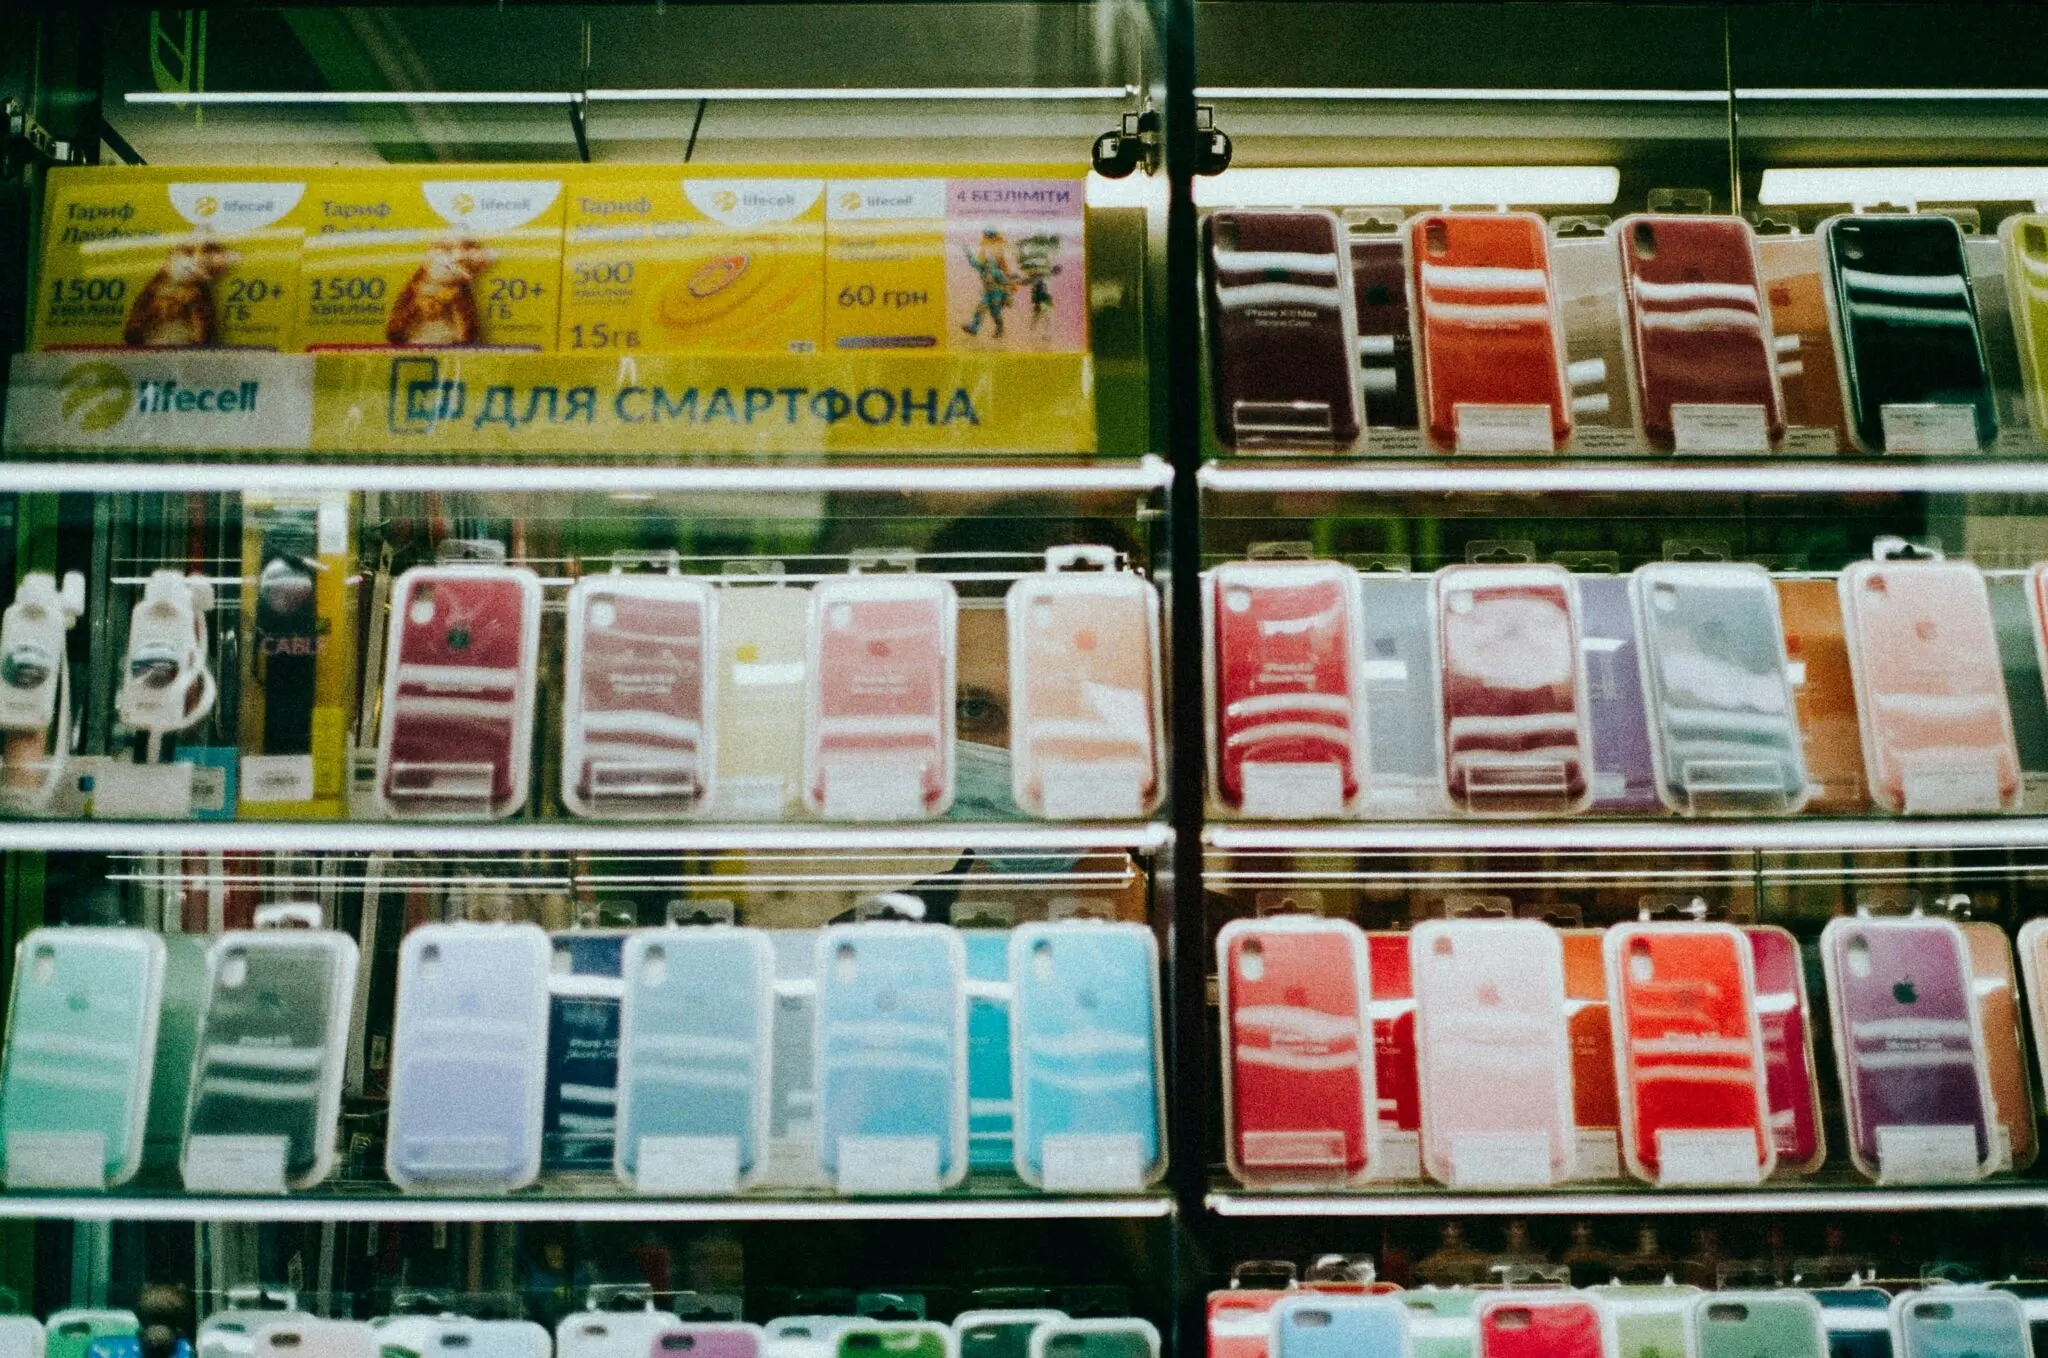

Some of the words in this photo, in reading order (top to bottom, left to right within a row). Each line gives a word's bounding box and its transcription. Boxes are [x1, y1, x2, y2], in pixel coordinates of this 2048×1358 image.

[577, 196, 652, 216] Тариф
[867, 195, 911, 206] lifecell
[970, 190, 1069, 203] БЕЗЛІМІТИ
[68, 203, 134, 221] Тариф
[320, 201, 391, 219] Тариф
[572, 261, 634, 285] 500
[52, 278, 125, 302] 1500
[226, 278, 284, 302] 20+
[310, 277, 386, 301] 1500
[489, 278, 545, 301] 20+
[838, 284, 875, 308] 60
[882, 290, 928, 309] грн
[138, 379, 259, 413] lifecell
[472, 384, 597, 432] ДЛЯ
[614, 384, 981, 427] СМАРТФОНА
